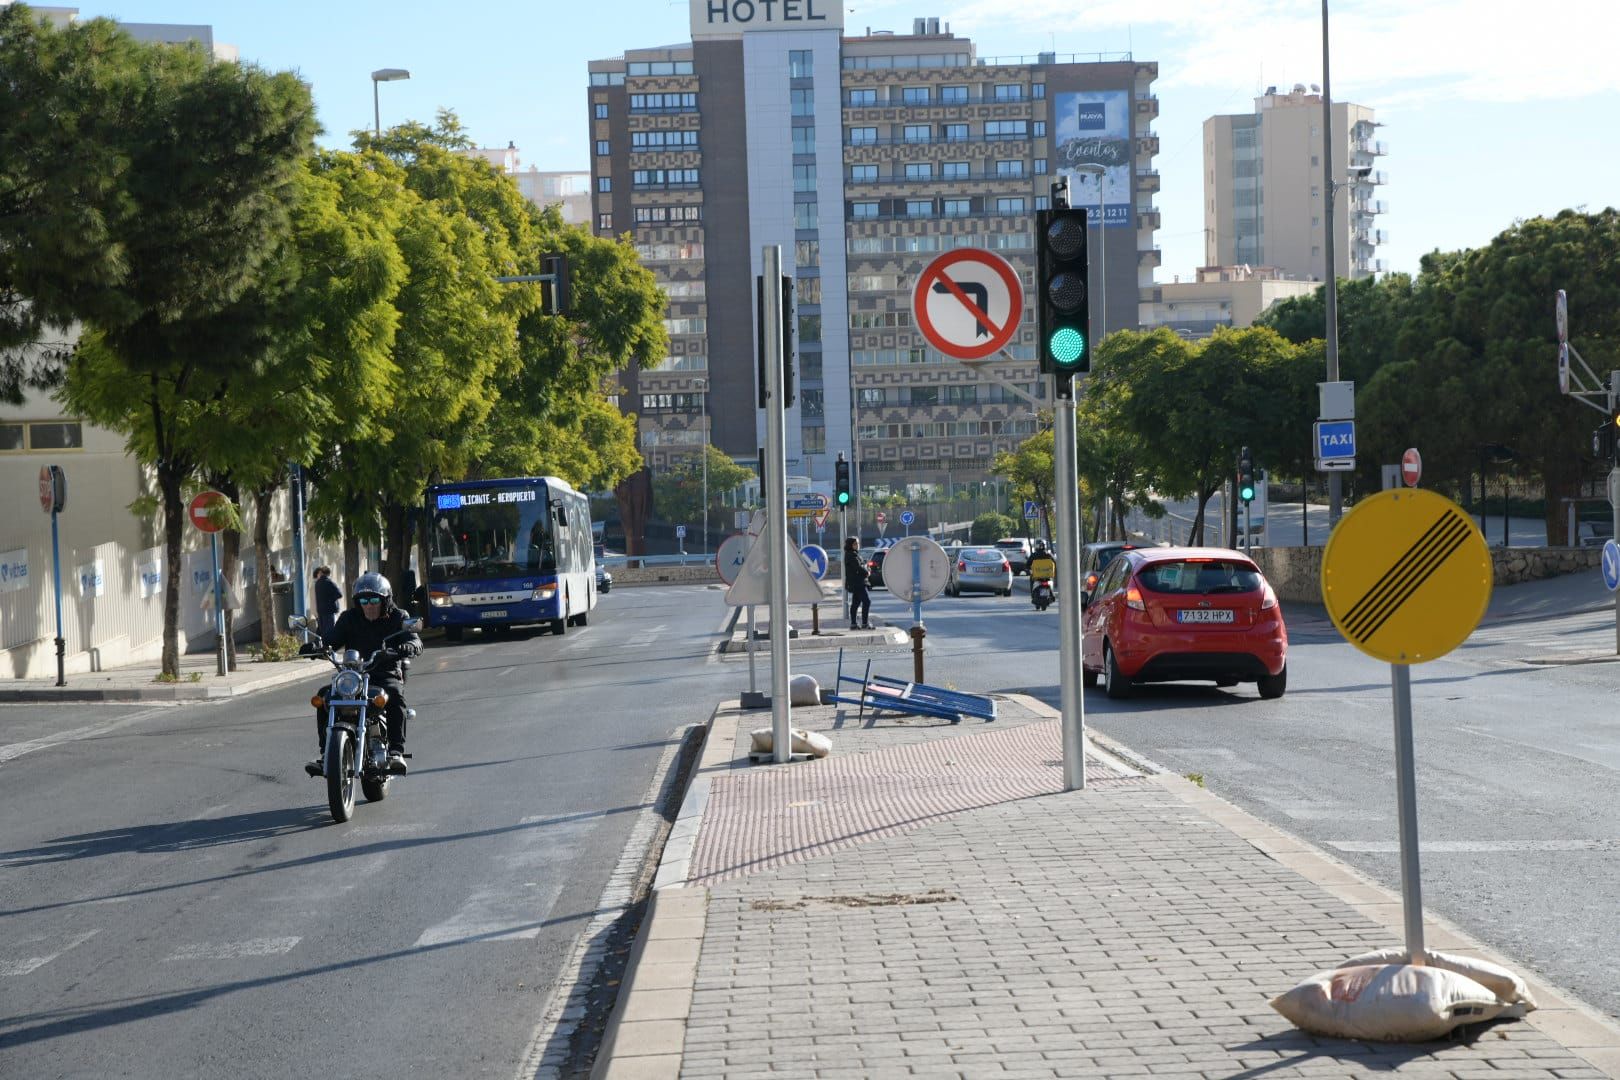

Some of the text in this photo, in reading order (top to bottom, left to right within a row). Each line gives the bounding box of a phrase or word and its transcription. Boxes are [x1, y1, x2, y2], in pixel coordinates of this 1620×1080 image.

[707, 0, 826, 23] HOTEL
[1066, 139, 1119, 161] Eventos
[1321, 433, 1353, 446] TAXI
[460, 493, 490, 505] ALICANTE
[497, 491, 536, 503] AEROPUERTO
[1183, 611, 1232, 620] 7132 HPX
